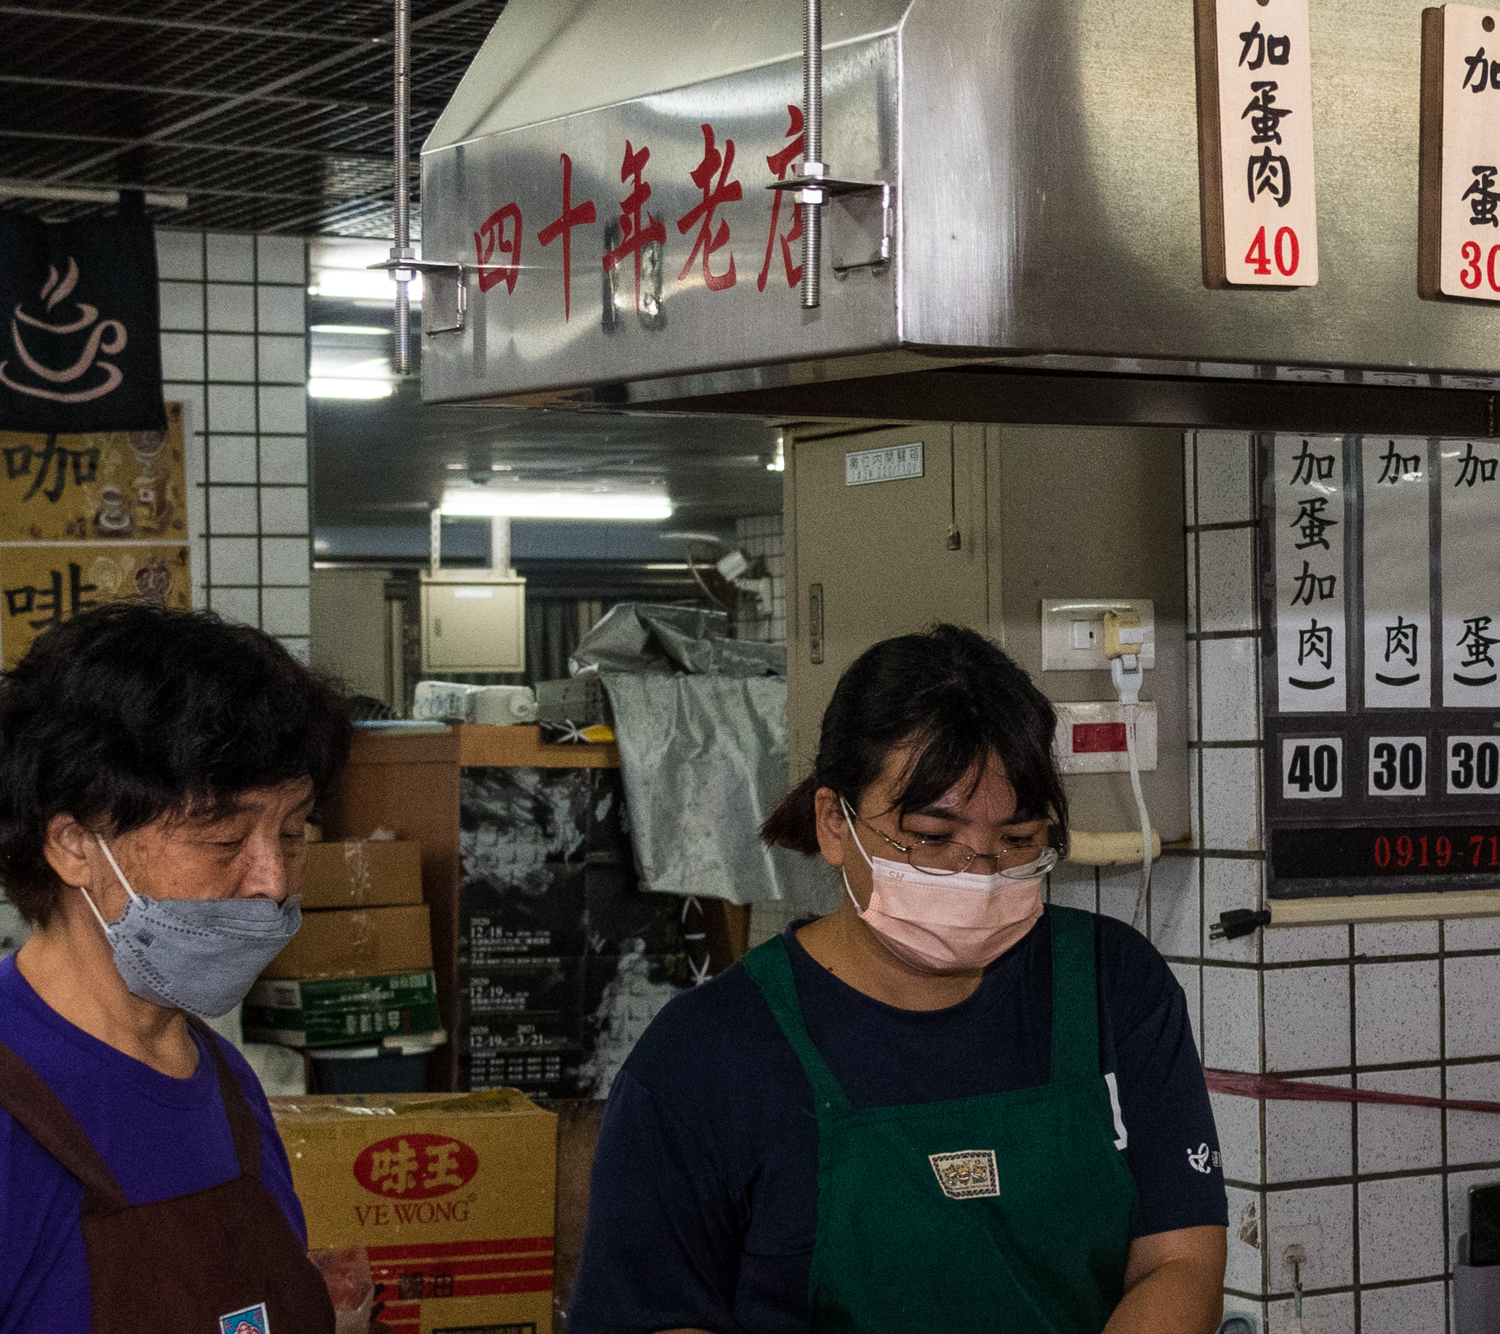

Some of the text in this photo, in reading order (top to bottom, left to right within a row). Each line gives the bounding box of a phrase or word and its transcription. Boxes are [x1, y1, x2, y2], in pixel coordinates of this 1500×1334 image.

[1239, 21, 1292, 208] 加蛋肉
[1244, 225, 1300, 277] 40
[1287, 744, 1339, 794] 40
[1373, 742, 1424, 793] 30
[1451, 741, 1500, 792] 30
[370, 1138, 464, 1194] 味王
[355, 1201, 470, 1227] VE WONG
